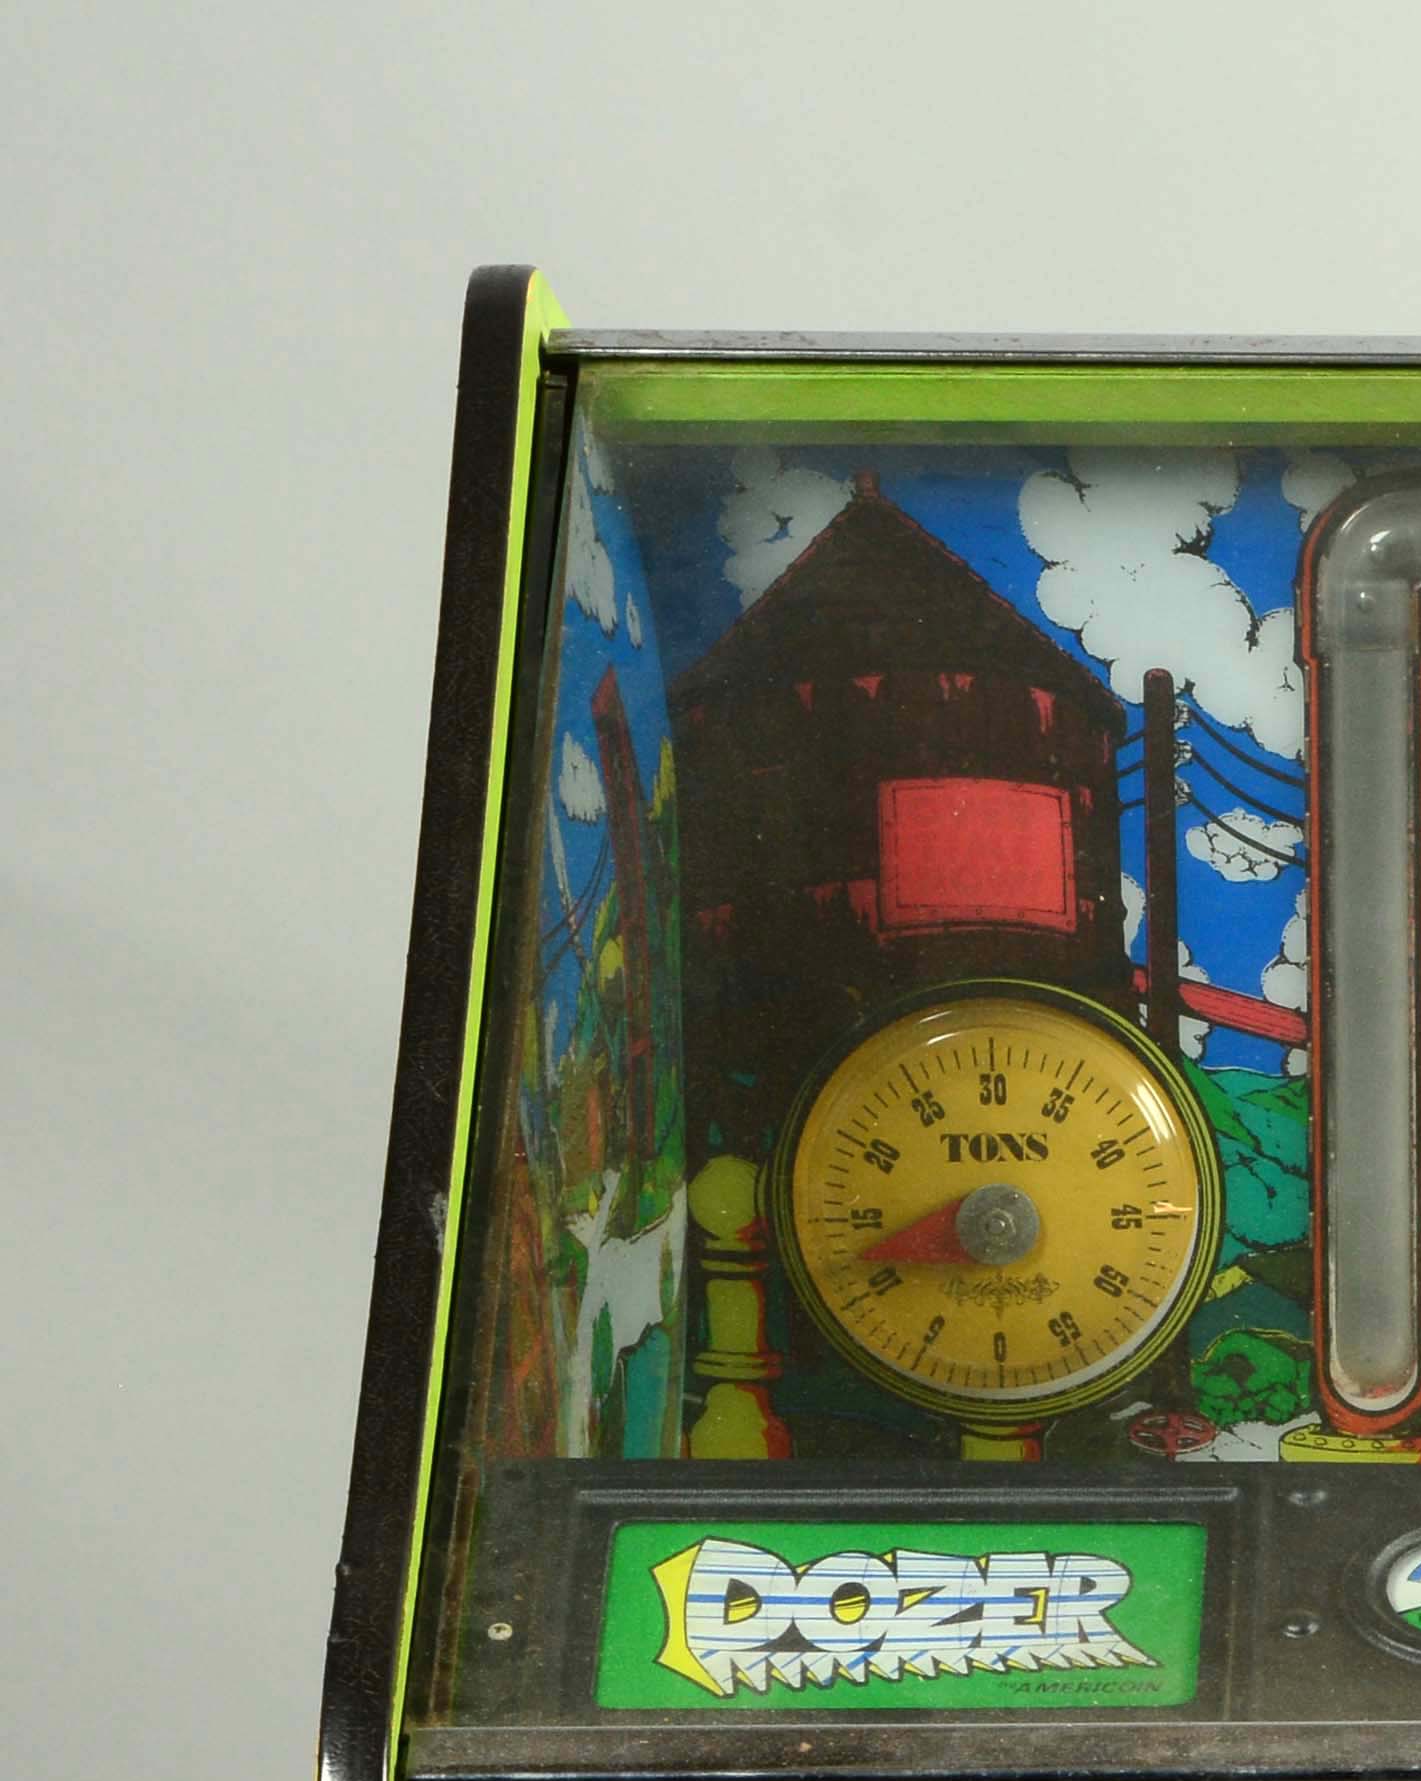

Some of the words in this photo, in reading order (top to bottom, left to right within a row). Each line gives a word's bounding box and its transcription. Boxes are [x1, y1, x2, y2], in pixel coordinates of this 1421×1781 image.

[979, 1074, 1007, 1105] 30
[911, 1092, 946, 1128] 25
[1041, 1088, 1075, 1124] 35
[864, 1138, 901, 1175] 20
[940, 1132, 1049, 1163] TONS
[1090, 1137, 1126, 1170] 40
[850, 1207, 883, 1230] 15
[1111, 1204, 1143, 1230] 45
[868, 1266, 903, 1297] 10
[1093, 1264, 1130, 1298] 50
[923, 1315, 946, 1345] 5
[1048, 1310, 1082, 1347] 55
[993, 1332, 1007, 1362] 0
[682, 1537, 1160, 1698] DOZER
[1014, 1681, 1162, 1693] AMERICOIN
